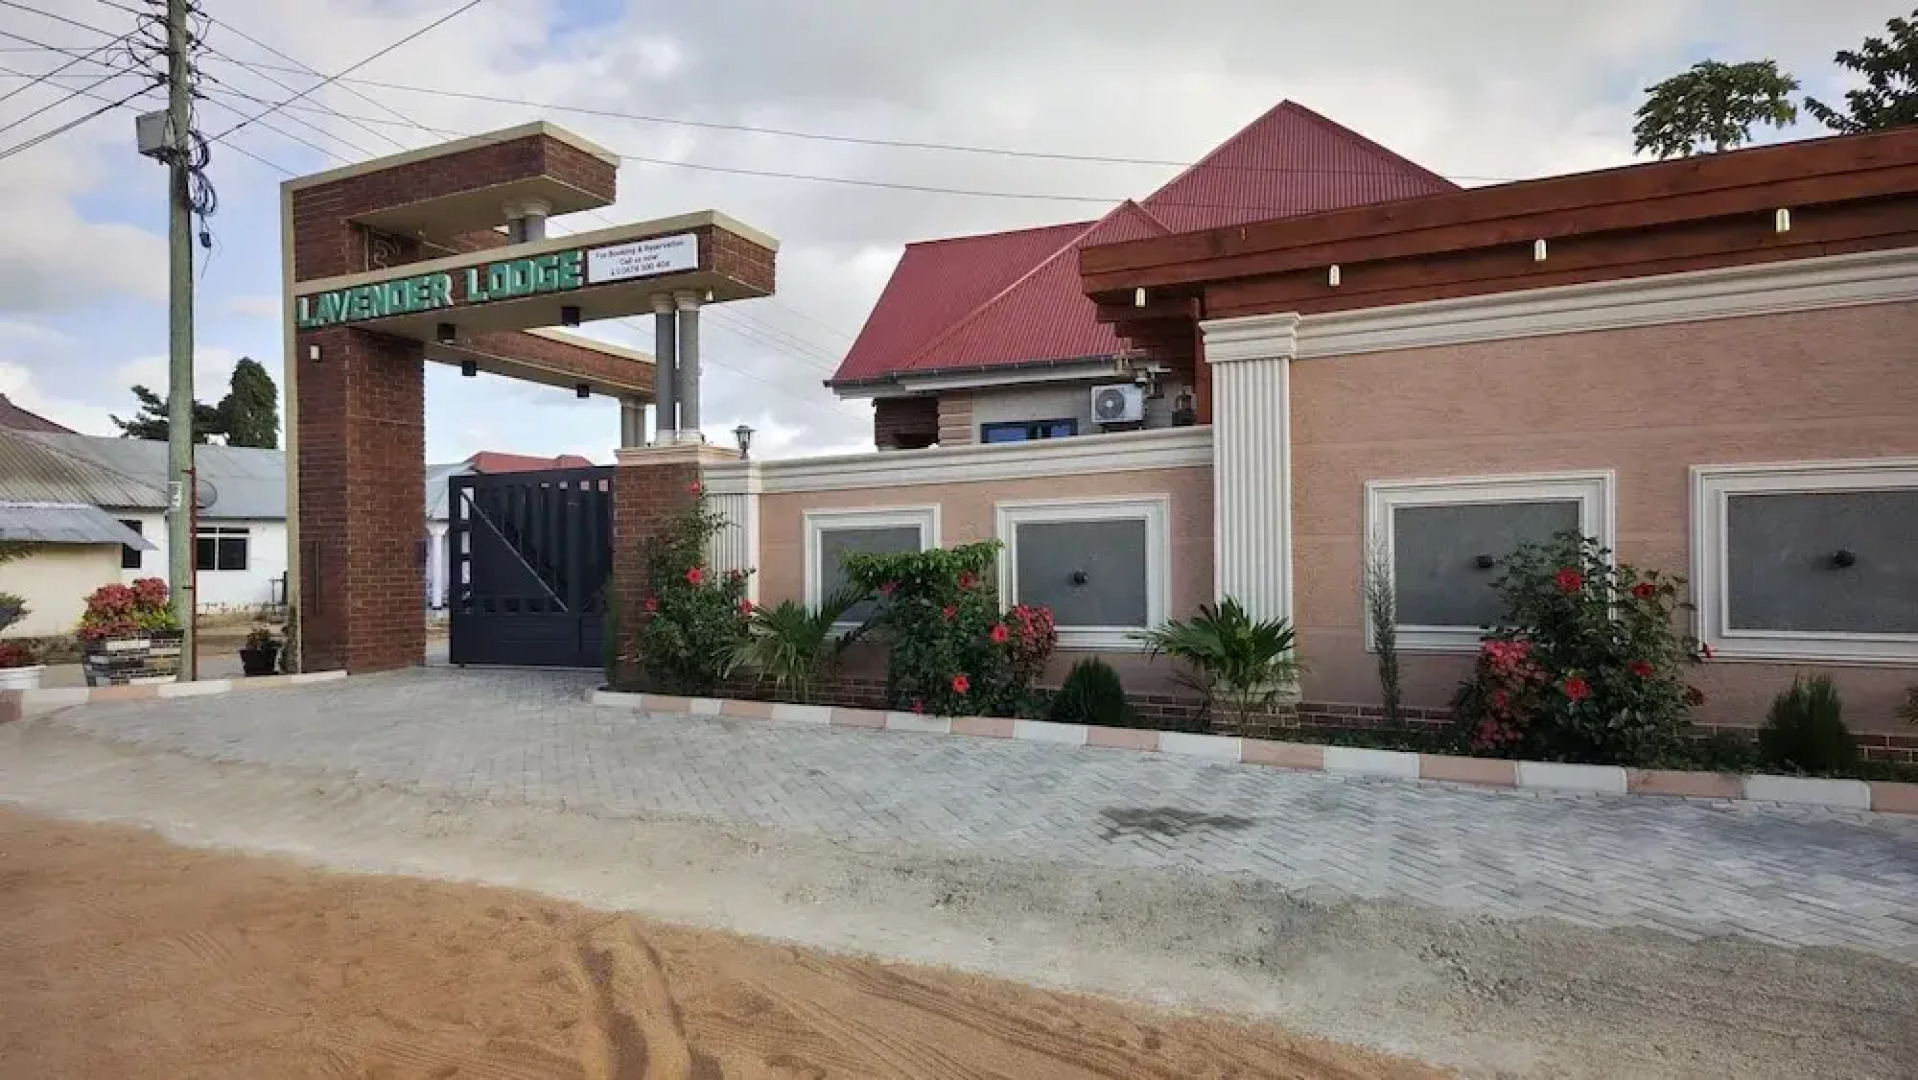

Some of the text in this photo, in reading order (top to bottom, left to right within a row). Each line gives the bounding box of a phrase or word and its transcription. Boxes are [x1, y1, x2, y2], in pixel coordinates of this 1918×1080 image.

[609, 248, 636, 258] Booking
[619, 256, 632, 265] Call
[296, 250, 584, 328] LAVENDER LODGE
